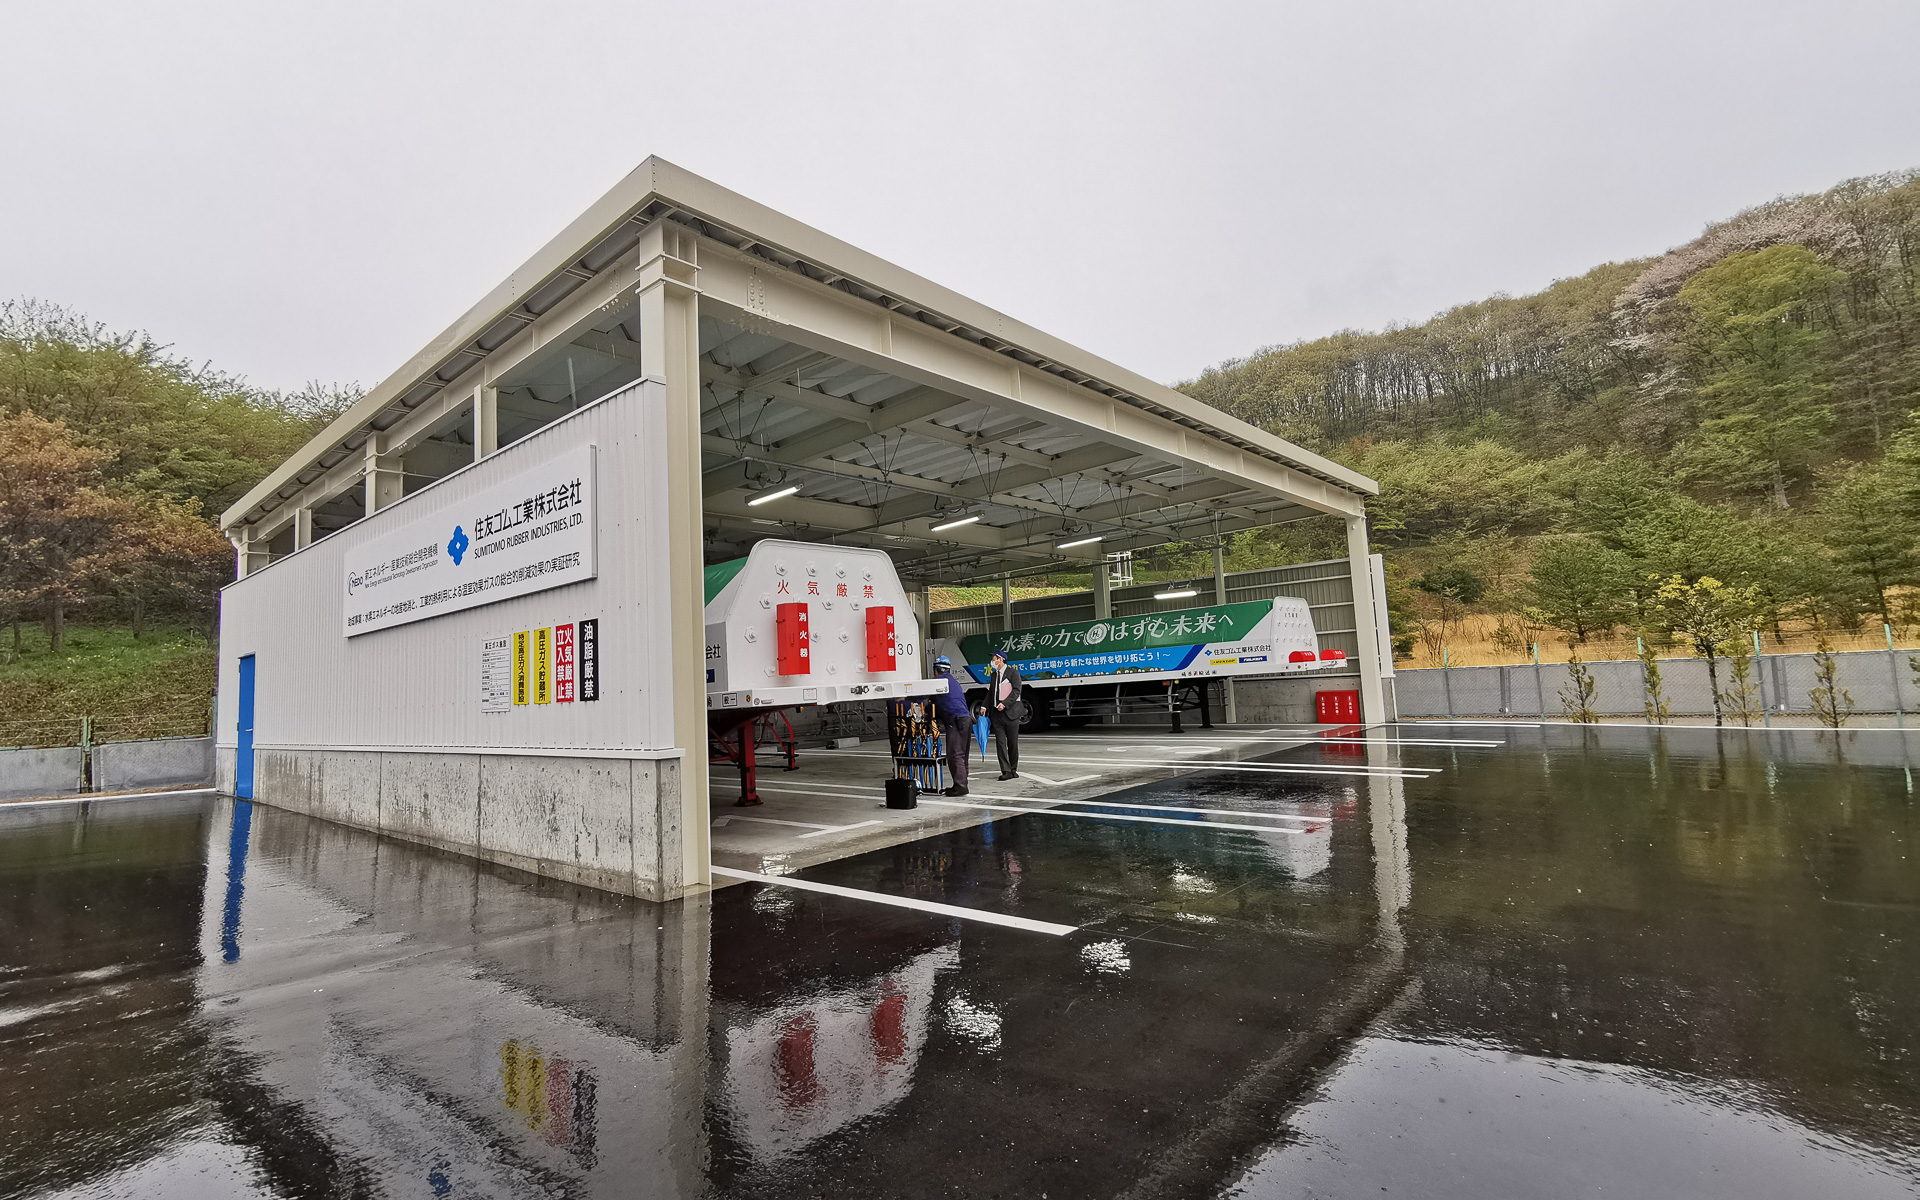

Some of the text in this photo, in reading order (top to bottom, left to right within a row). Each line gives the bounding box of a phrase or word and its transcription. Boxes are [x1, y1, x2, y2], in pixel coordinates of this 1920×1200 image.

[474, 477, 582, 542] 住友ゴム工業株式会社
[474, 512, 584, 559] SUMITOMO RUBBER INDUSTRIES, LTD.
[777, 579, 875, 599] 火気厳禁
[564, 627, 573, 699] 火気厳禁
[583, 621, 594, 699] 油脂厳禁
[798, 612, 809, 658] 消火器
[886, 614, 895, 657] 消火器
[1213, 644, 1272, 656] 住友ゴム工業株式会社
[538, 629, 546, 702] 高圧ガス貯蔵所
[556, 629, 565, 700] 立入禁止
